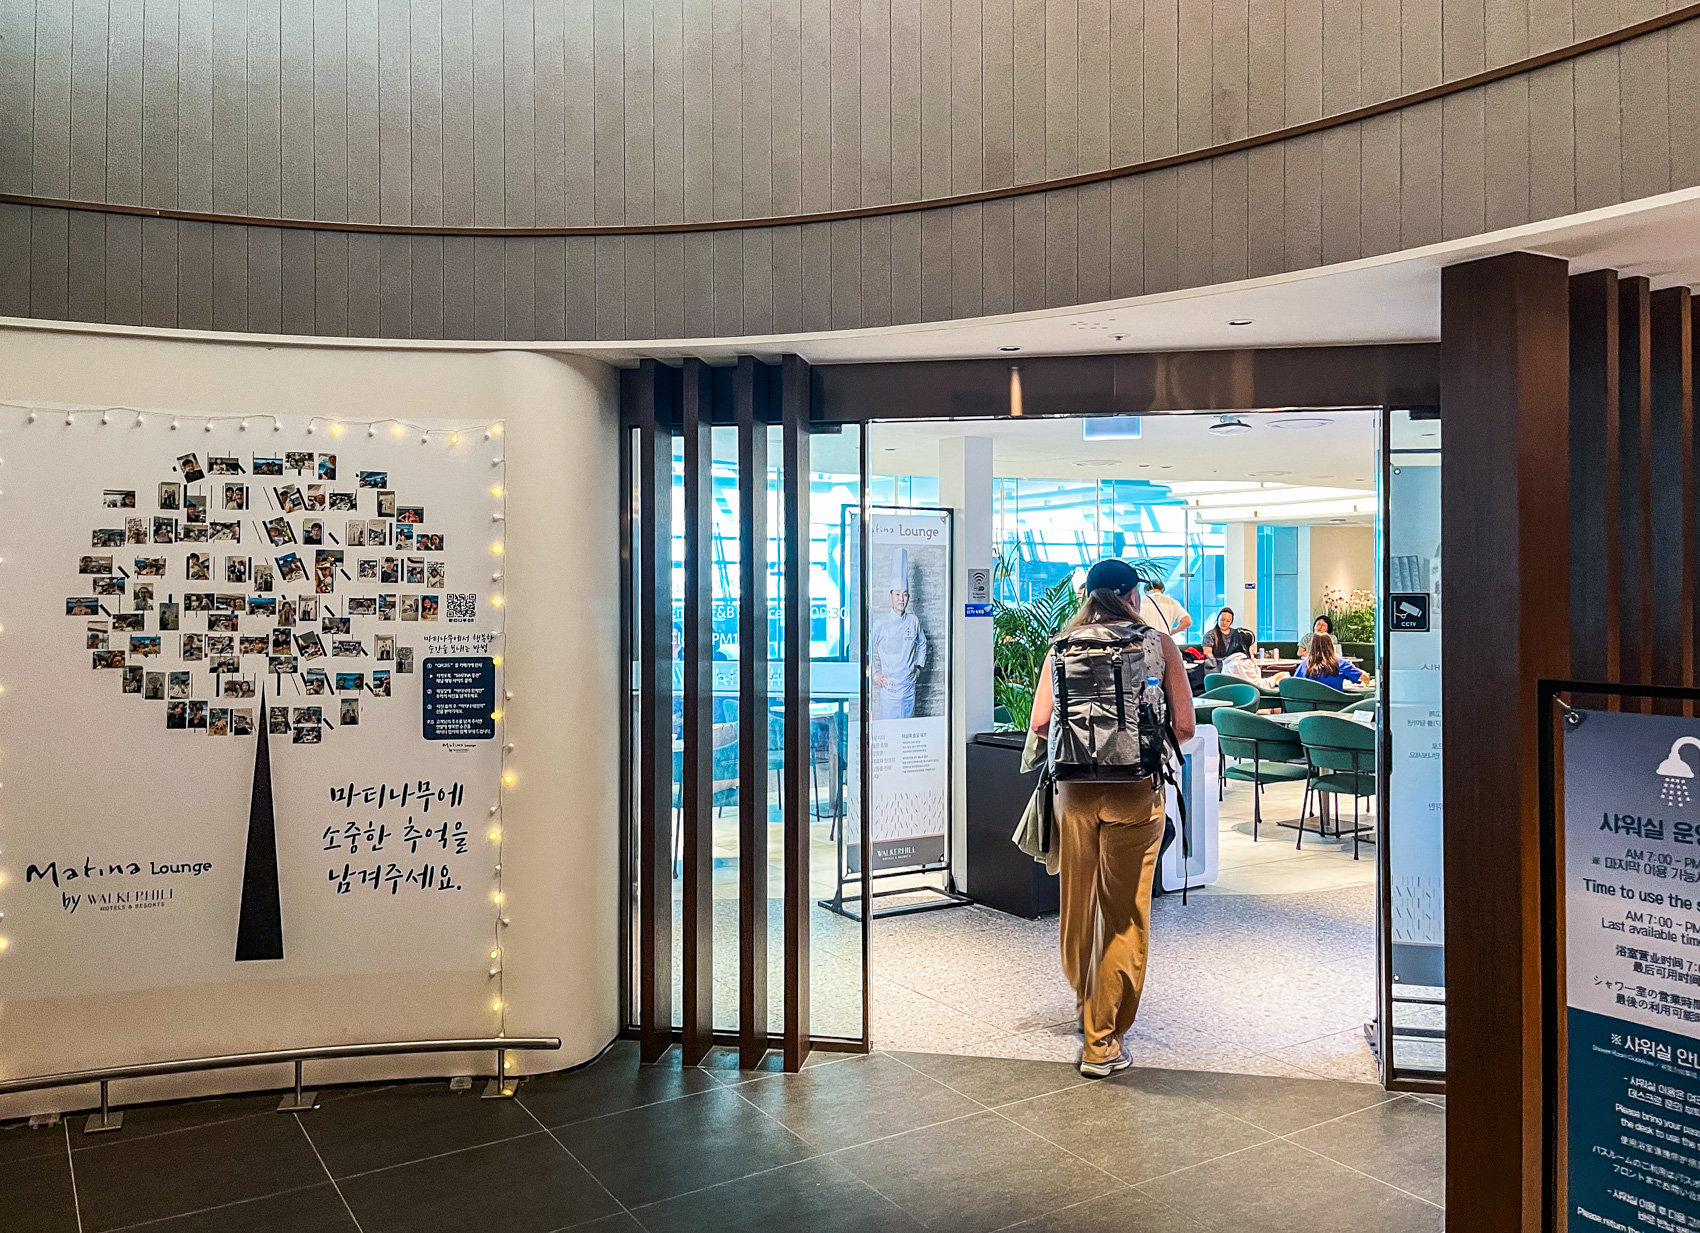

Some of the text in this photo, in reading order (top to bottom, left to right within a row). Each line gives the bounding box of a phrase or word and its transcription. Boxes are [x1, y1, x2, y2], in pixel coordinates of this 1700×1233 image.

[899, 524, 939, 540] Lounge
[810, 606, 848, 619] 09:30
[428, 643, 488, 654] 순간을 보내는 방법
[473, 633, 494, 643] 행복한
[330, 780, 464, 813] 마티나무에
[322, 816, 469, 855] 소중한 추억을
[1599, 812, 1665, 840] 샤워실
[877, 846, 916, 857] WALKERHILL
[1625, 848, 1644, 861] AM
[1646, 851, 1673, 866] 7:00
[26, 856, 213, 888] Matina Lounge
[328, 863, 462, 895] 남겨주세요.
[1604, 856, 1641, 874] 마지막
[1644, 863, 1667, 879] 이용
[62, 891, 81, 914] by
[1583, 878, 1616, 896] Time
[1620, 885, 1635, 899] to
[1639, 890, 1664, 905] use
[1668, 893, 1692, 910] the
[1601, 917, 1626, 932] Last
[1629, 925, 1678, 942] available
[1625, 910, 1644, 923] AM
[1646, 913, 1673, 929] 7:00
[1624, 1035, 1672, 1062] 샤워실
[1630, 1076, 1657, 1092] 샤워실
[1615, 1103, 1641, 1119] Please
[1642, 1112, 1663, 1126] bring
[1663, 1119, 1682, 1131] your
[1620, 1117, 1634, 1129] the
[1634, 1123, 1654, 1135] desk
[1655, 1129, 1665, 1139] to
[1665, 1132, 1681, 1144] use
[1681, 1137, 1696, 1149] the
[1612, 1189, 1638, 1206] 샤워실
[1577, 1206, 1602, 1223] Please
[1602, 1218, 1627, 1232] return
